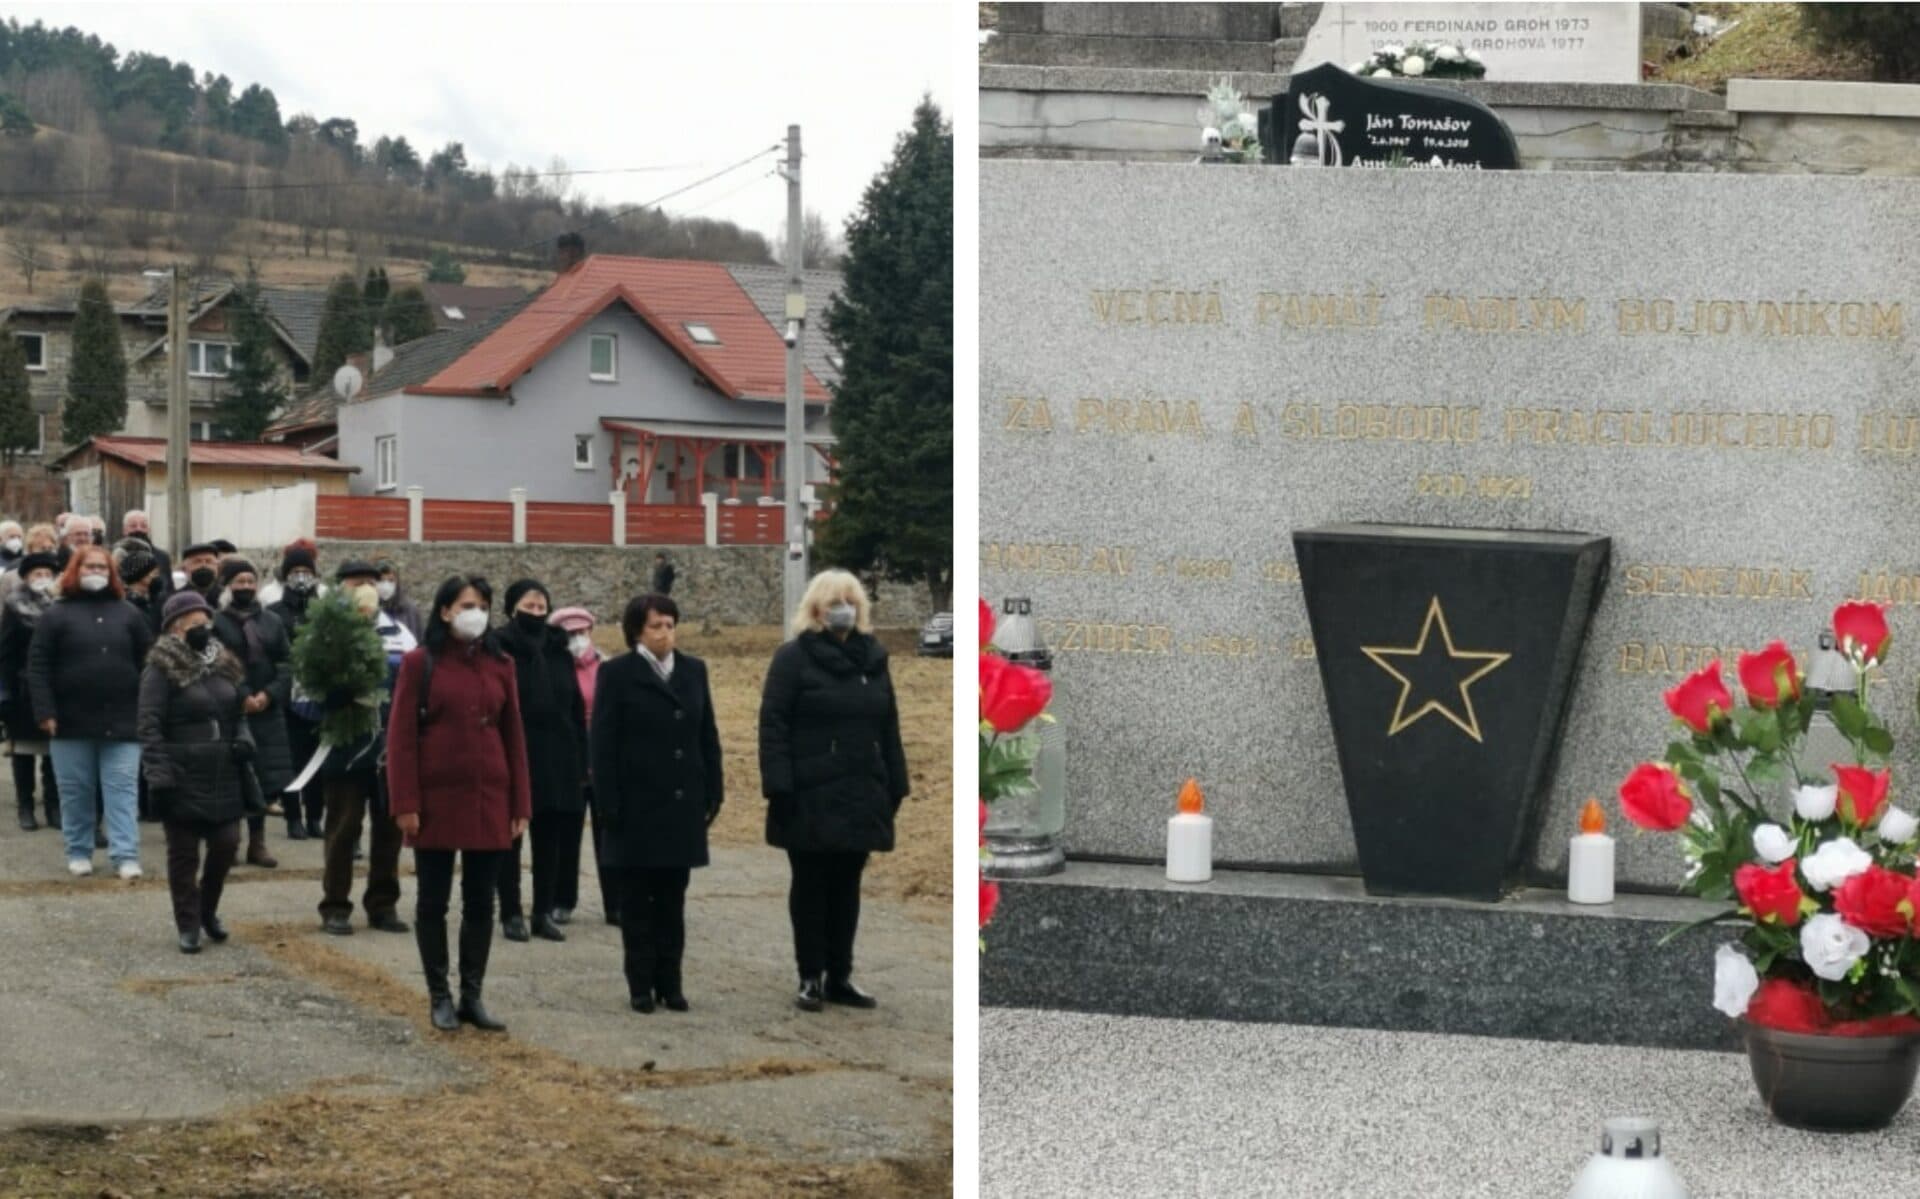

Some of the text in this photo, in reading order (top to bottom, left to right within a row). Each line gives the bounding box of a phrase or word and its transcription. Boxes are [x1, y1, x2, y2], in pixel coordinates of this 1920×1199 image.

[1404, 20, 1497, 33] FERDINAND
[1504, 18, 1550, 32] GROH
[1555, 18, 1590, 31] 1973
[1366, 113, 1471, 132] Ján Tomašov
[1005, 396, 1054, 433] ZA
[1233, 401, 1258, 438] A
[1282, 402, 1480, 442] SLOBODU
